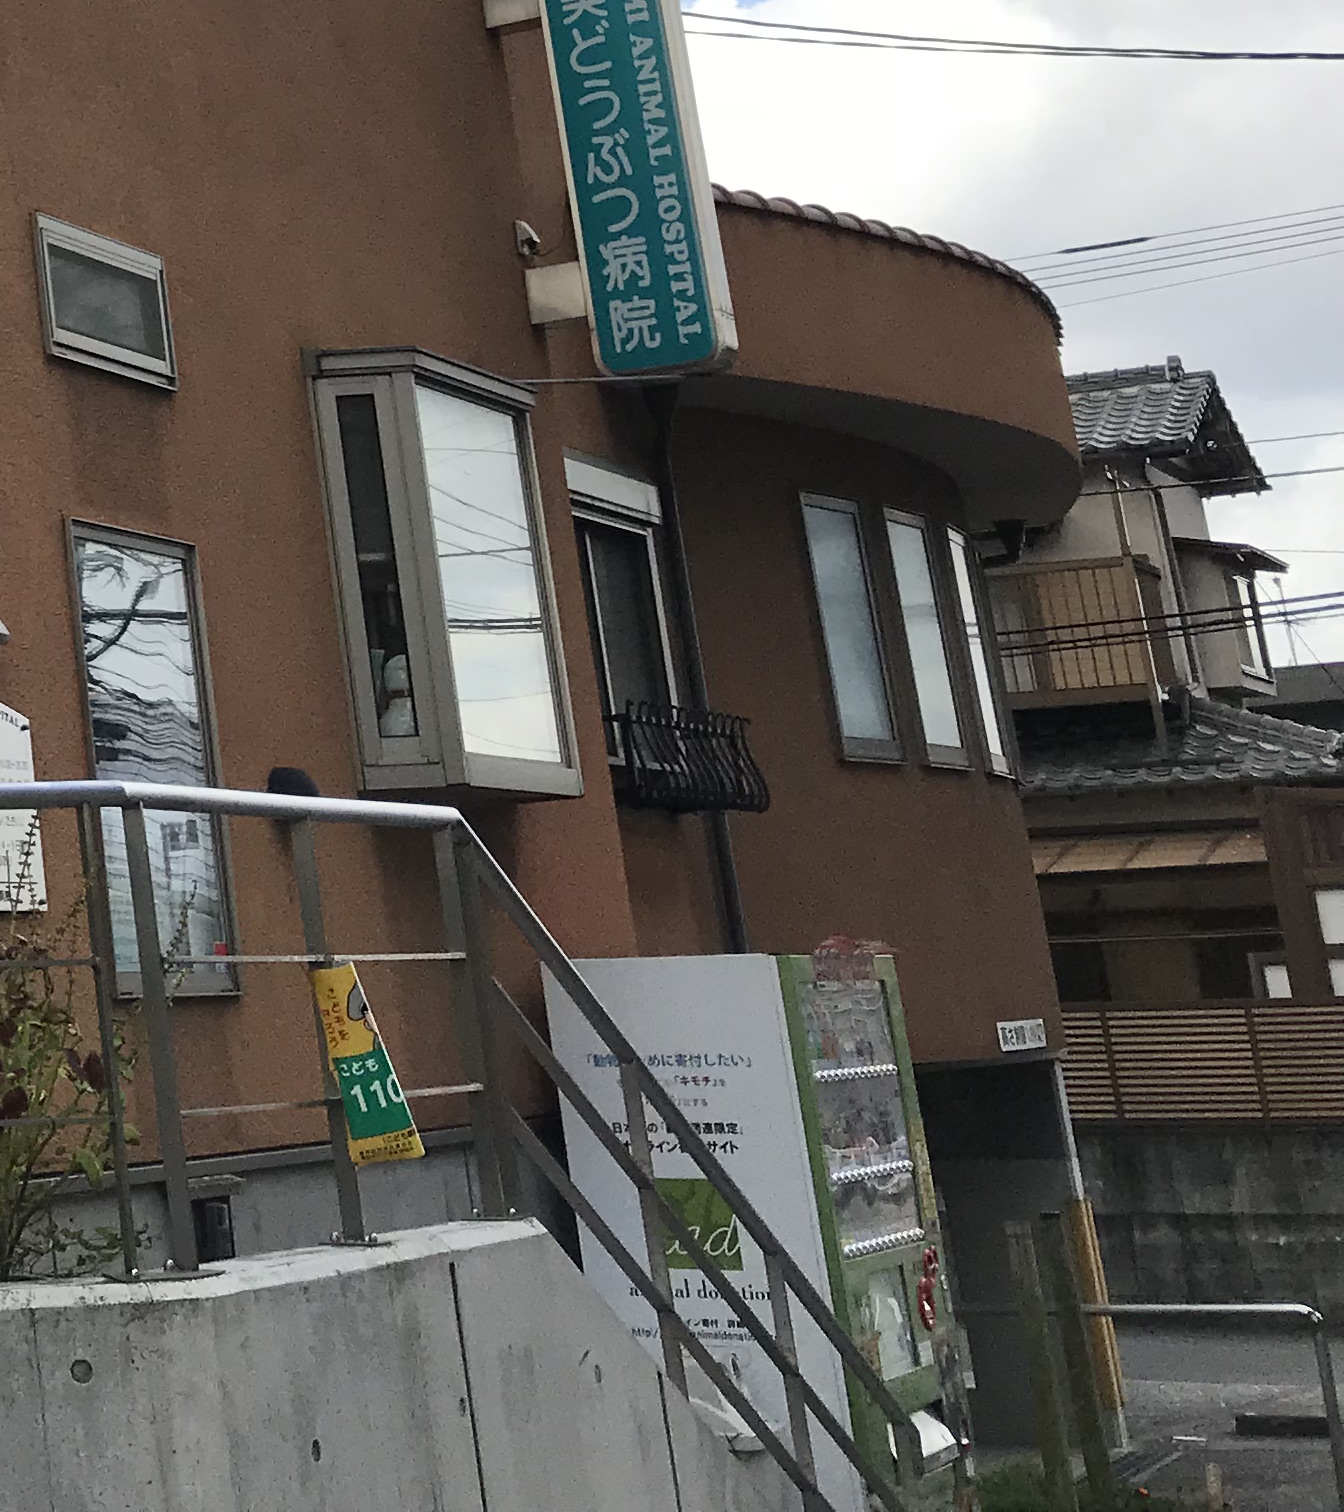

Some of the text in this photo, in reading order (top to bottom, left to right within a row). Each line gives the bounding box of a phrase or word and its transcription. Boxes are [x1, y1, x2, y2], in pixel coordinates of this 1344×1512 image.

[628, 32, 673, 166] ANIMAL
[652, 172, 703, 345] HOSPITAL
[338, 1057, 380, 1077] こども
[585, 1053, 753, 1068] 「動物めに寄付したい」
[350, 1073, 405, 1113] 110
[629, 1278, 773, 1301] aal dotio
